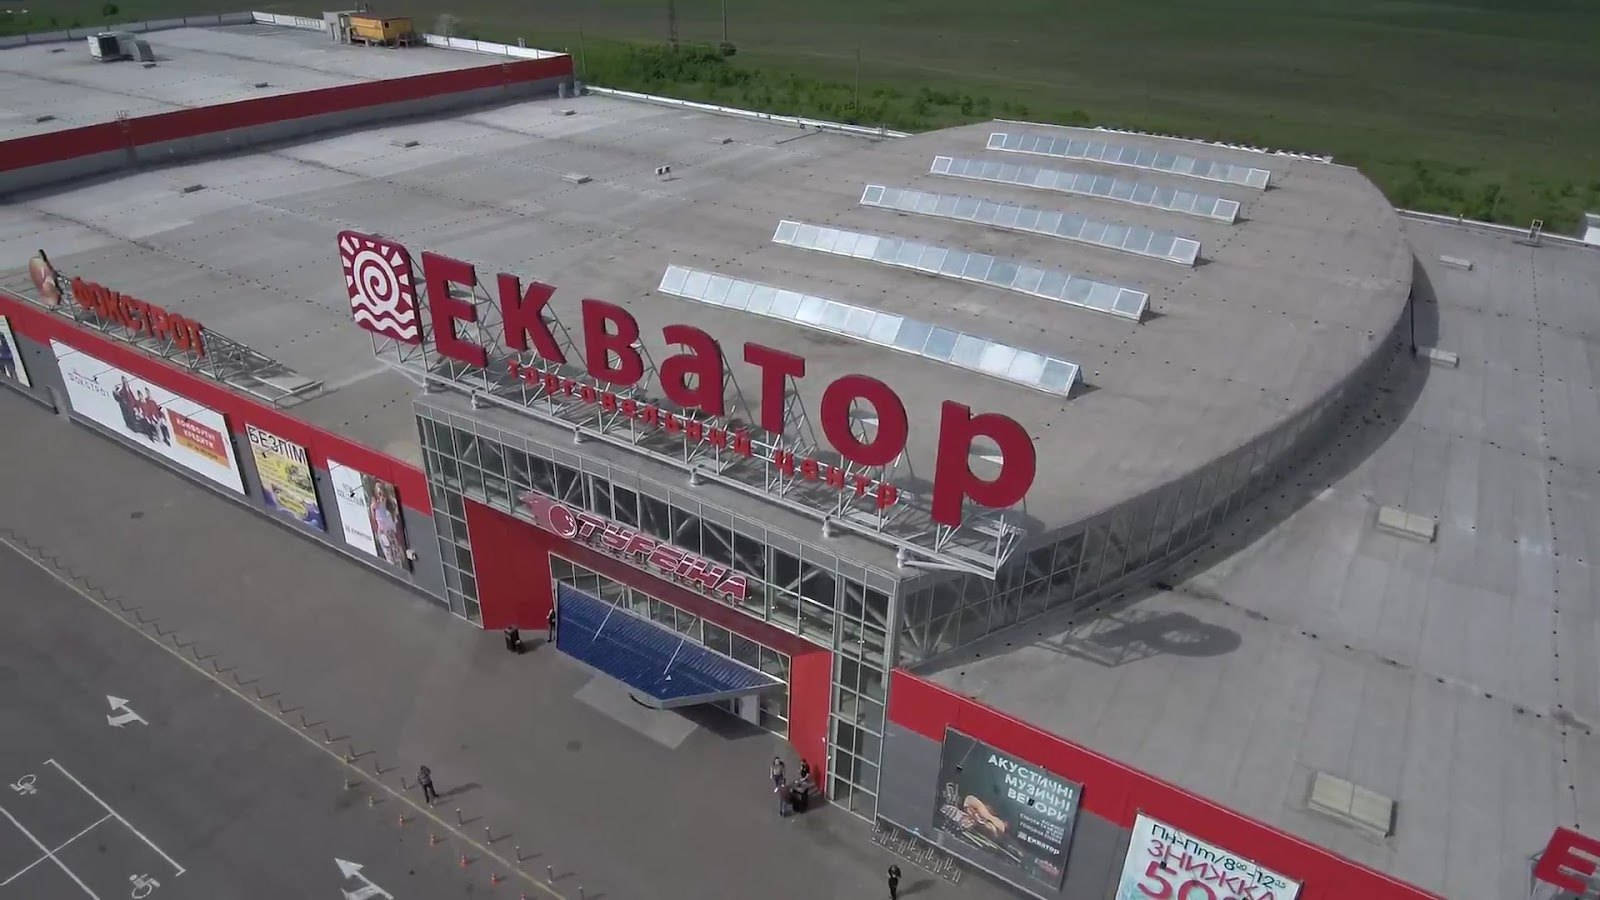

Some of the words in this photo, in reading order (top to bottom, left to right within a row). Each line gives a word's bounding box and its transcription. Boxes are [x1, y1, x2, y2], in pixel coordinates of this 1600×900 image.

[71, 276, 206, 358] ФОКСТРОТ
[507, 360, 753, 458] торговельний
[774, 450, 898, 509] центр
[987, 754, 1074, 800] АКУСТИЧНІ
[1004, 773, 1071, 812] МУЗИЧНІ
[1535, 826, 1600, 895] Е
